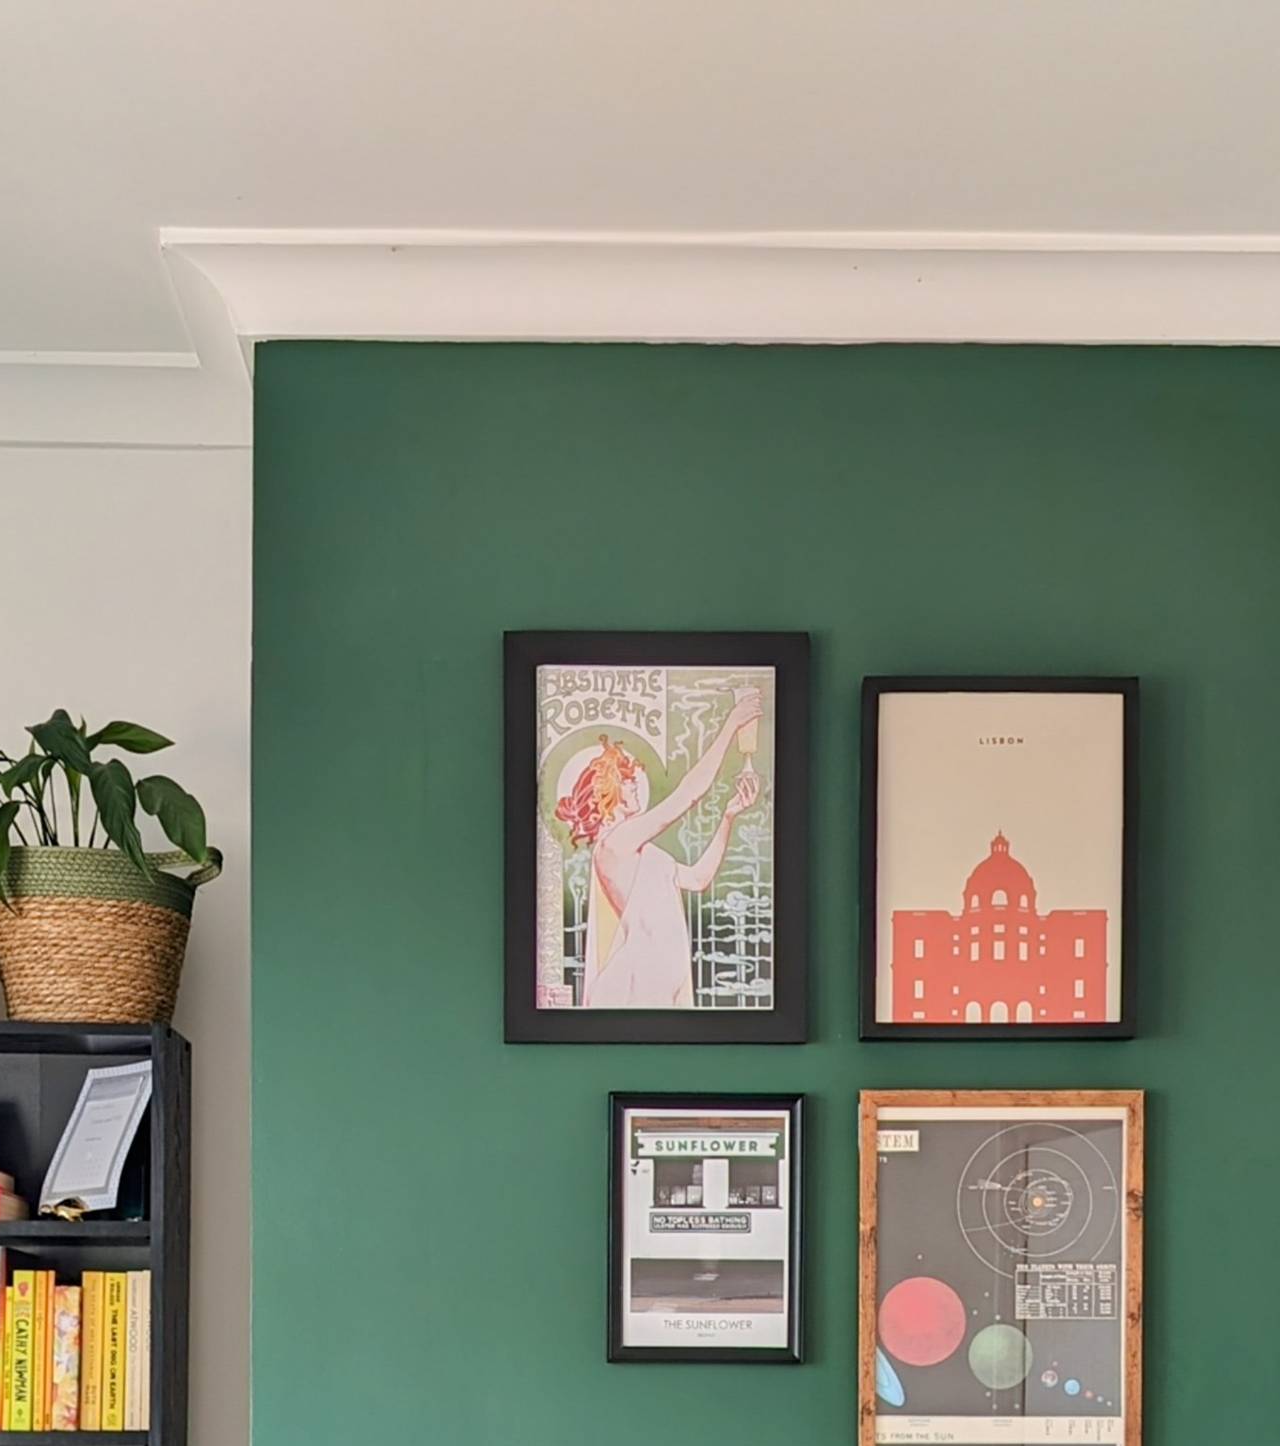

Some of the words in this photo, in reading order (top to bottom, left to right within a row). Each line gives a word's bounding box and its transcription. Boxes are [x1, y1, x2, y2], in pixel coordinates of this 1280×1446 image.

[538, 669, 663, 700] ABSINTHE
[539, 697, 662, 738] ROBETTE
[979, 737, 1024, 745] LISBON
[655, 1140, 759, 1151] SUNFLOWER
[653, 1216, 666, 1224] NO
[668, 1216, 706, 1224] TOPLESS
[708, 1216, 748, 1224] BATHING
[129, 1309, 138, 1353] ATWOOD
[664, 1319, 683, 1329] THE
[686, 1319, 753, 1330] SUNFLOWER
[16, 1319, 29, 1354] CATHY
[110, 1349, 118, 1366] DOG
[15, 1359, 28, 1402] NEWMAN
[110, 1367, 117, 1380] ON
[934, 1432, 954, 1440] SUN
